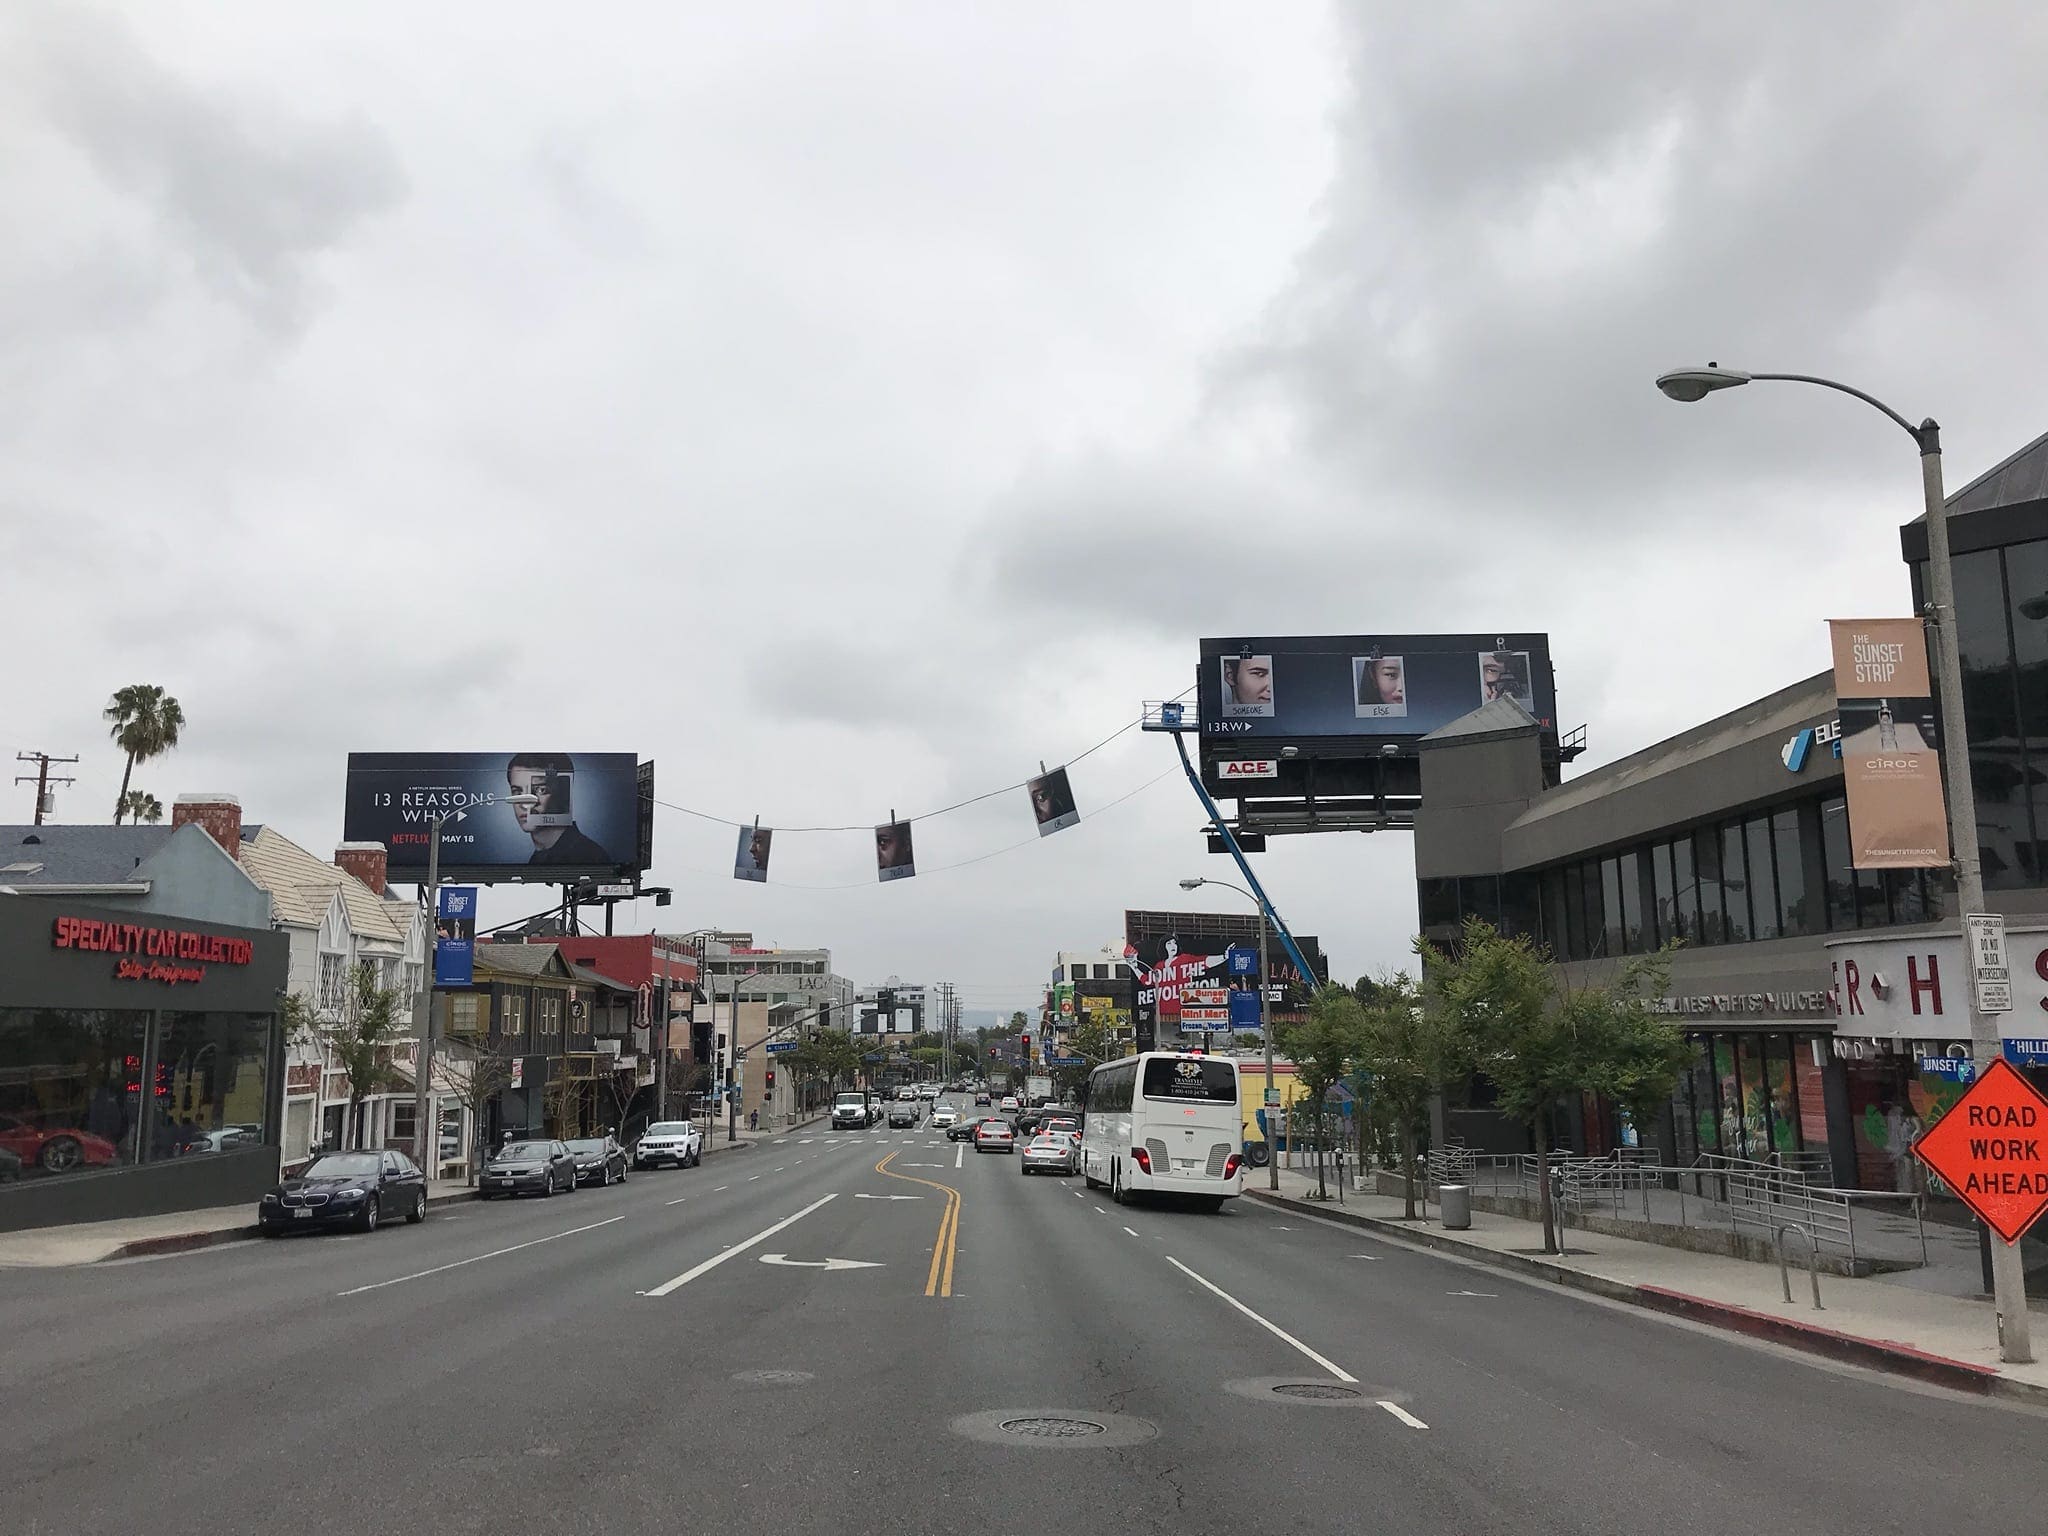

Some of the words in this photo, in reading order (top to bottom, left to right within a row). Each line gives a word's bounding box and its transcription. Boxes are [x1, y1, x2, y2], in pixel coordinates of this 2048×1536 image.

[1852, 634, 1870, 644] THE
[1853, 643, 1904, 664] SUNSET
[1856, 663, 1896, 683] STRIP
[1208, 722, 1243, 732] 13RW
[1226, 762, 1269, 774] ACE
[375, 793, 392, 806] 13
[402, 792, 495, 806] REASONS
[402, 809, 451, 823] WHY
[391, 833, 430, 845] NETFLIX
[441, 835, 462, 843] MAY
[464, 835, 474, 843] 18
[447, 896, 468, 905] SUNSET
[447, 904, 464, 913] STRIP
[55, 916, 145, 954] SPECIALTY
[146, 928, 177, 957] CAR
[179, 932, 254, 965] COLLECTION
[1980, 938, 1988, 951] DO
[1989, 938, 1999, 951] NOT
[1983, 953, 2000, 966] BLOCK
[1145, 966, 1177, 985] JOIN
[1180, 960, 1206, 979] THE
[1977, 968, 2008, 980] INTERSECTION
[1195, 989, 1227, 997] Sunset
[1181, 1009, 1202, 1018] Mini
[1204, 1009, 1228, 1018] Mart
[1182, 1021, 1203, 1030] Frozen
[1207, 1021, 1228, 1031] Yogurt
[1923, 1058, 1958, 1072] SUNSET
[1968, 1105, 2037, 1128] ROAD
[1970, 1138, 2041, 1161] WORK
[1965, 1172, 2048, 1195] AHEAD
